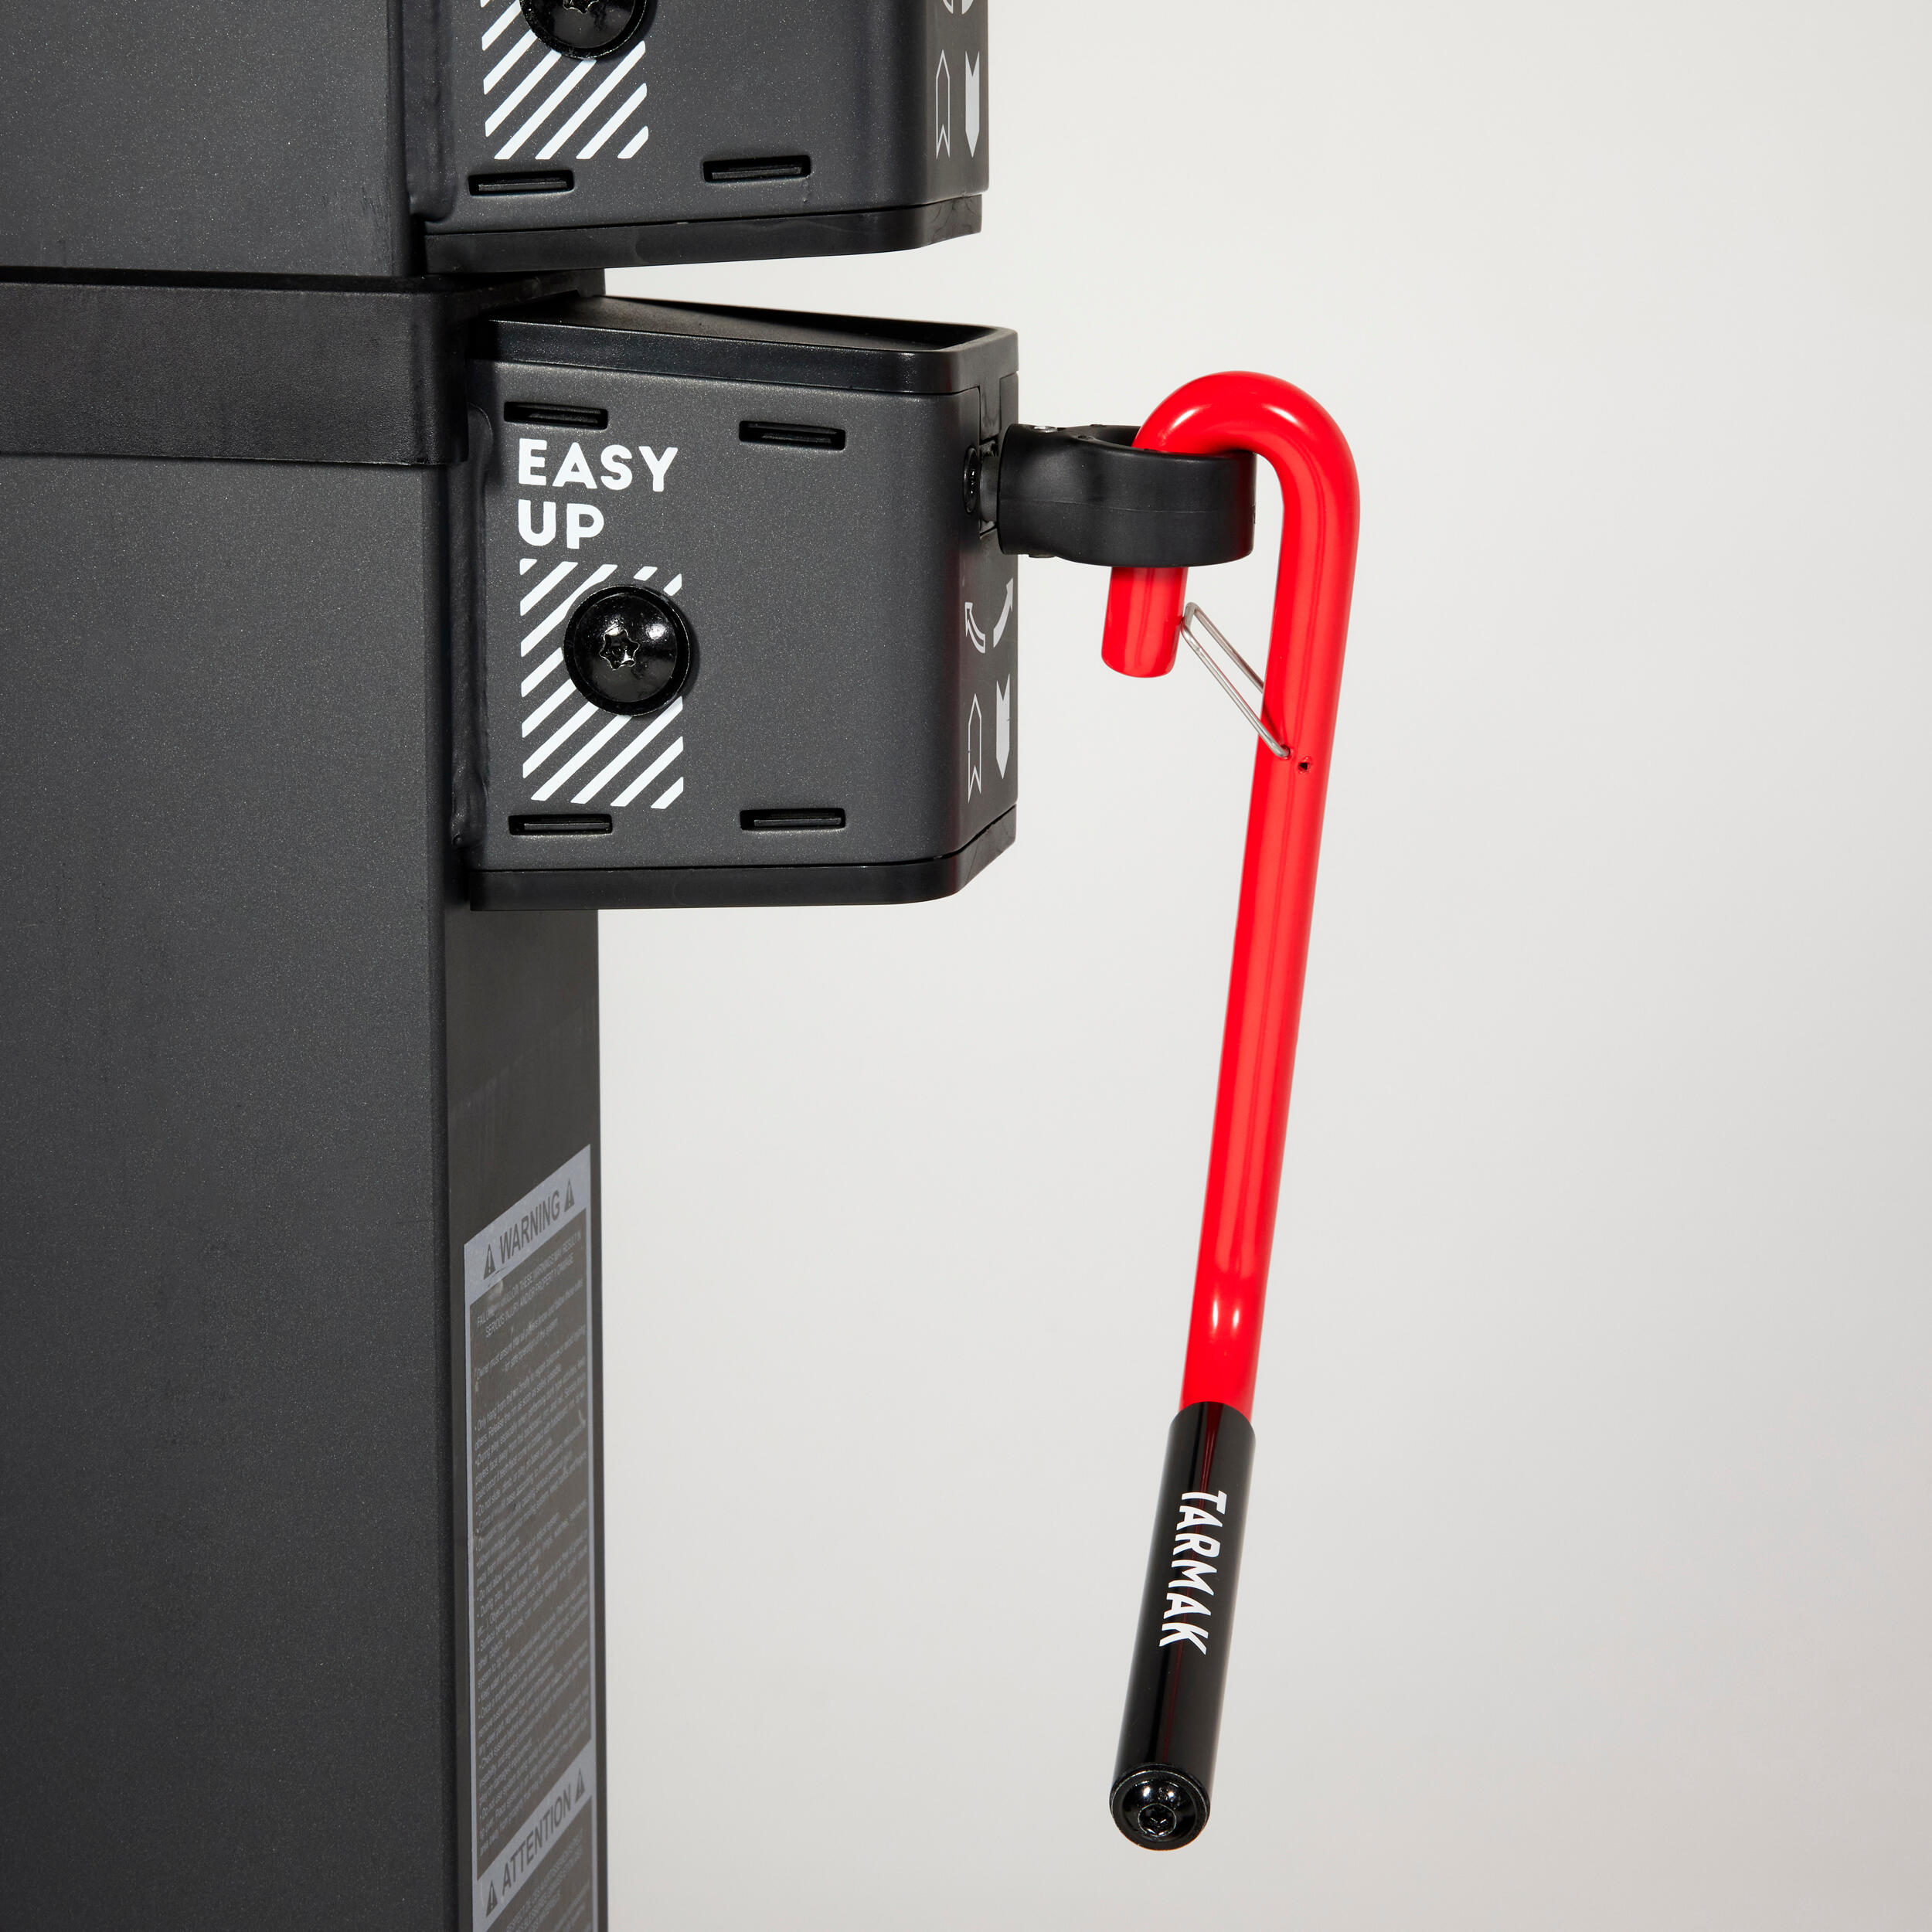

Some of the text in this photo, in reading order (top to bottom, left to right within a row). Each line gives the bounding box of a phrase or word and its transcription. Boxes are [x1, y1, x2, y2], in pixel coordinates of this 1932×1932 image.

[519, 438, 679, 492] EASY
[518, 499, 604, 549] UP
[499, 1189, 560, 1264] WARNING
[1158, 1490, 1227, 1655] TARMAK
[502, 1784, 571, 1896] ATTENTION
